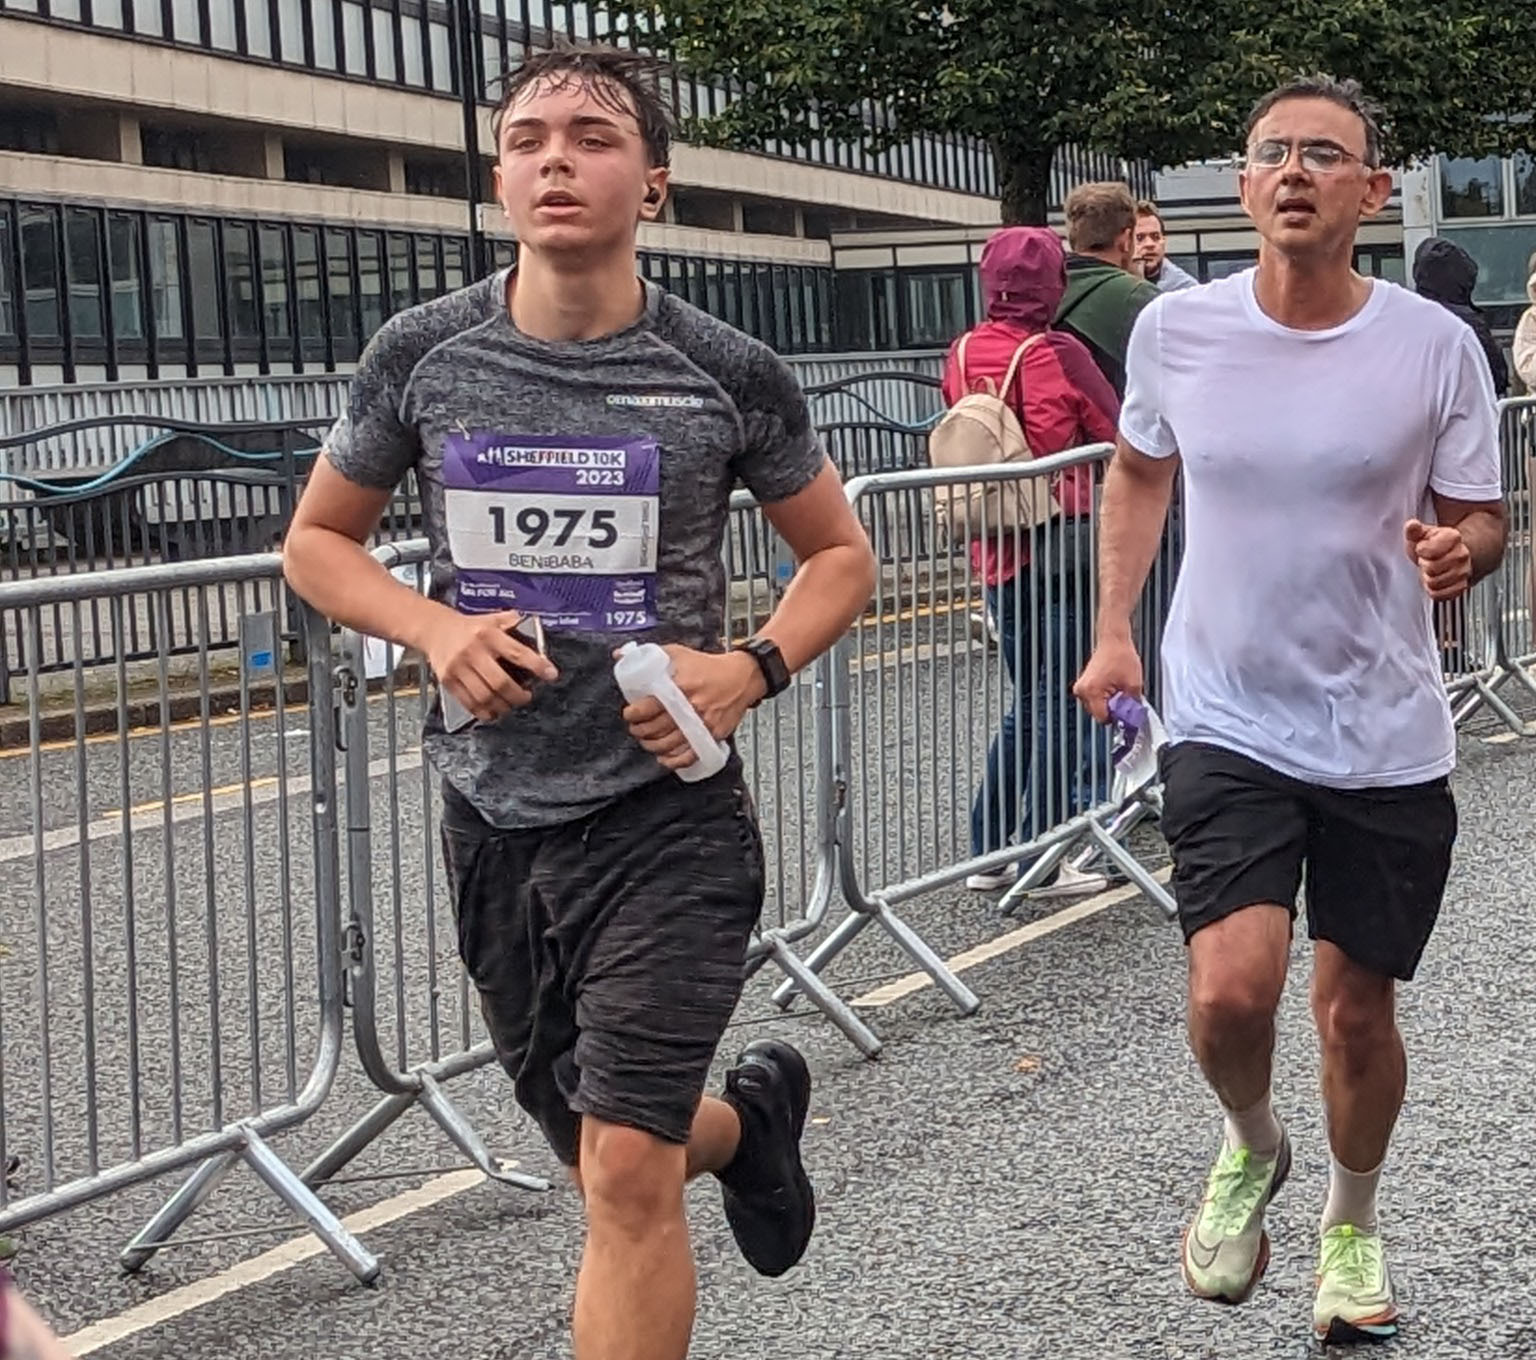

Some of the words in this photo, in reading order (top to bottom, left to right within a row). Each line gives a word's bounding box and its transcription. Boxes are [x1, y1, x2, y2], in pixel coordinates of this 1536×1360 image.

[506, 450, 590, 465] SHEFFIELD
[592, 452, 623, 466] 10K
[576, 469, 624, 486] 2023
[488, 506, 618, 549] 1975
[606, 610, 646, 626] 1975
